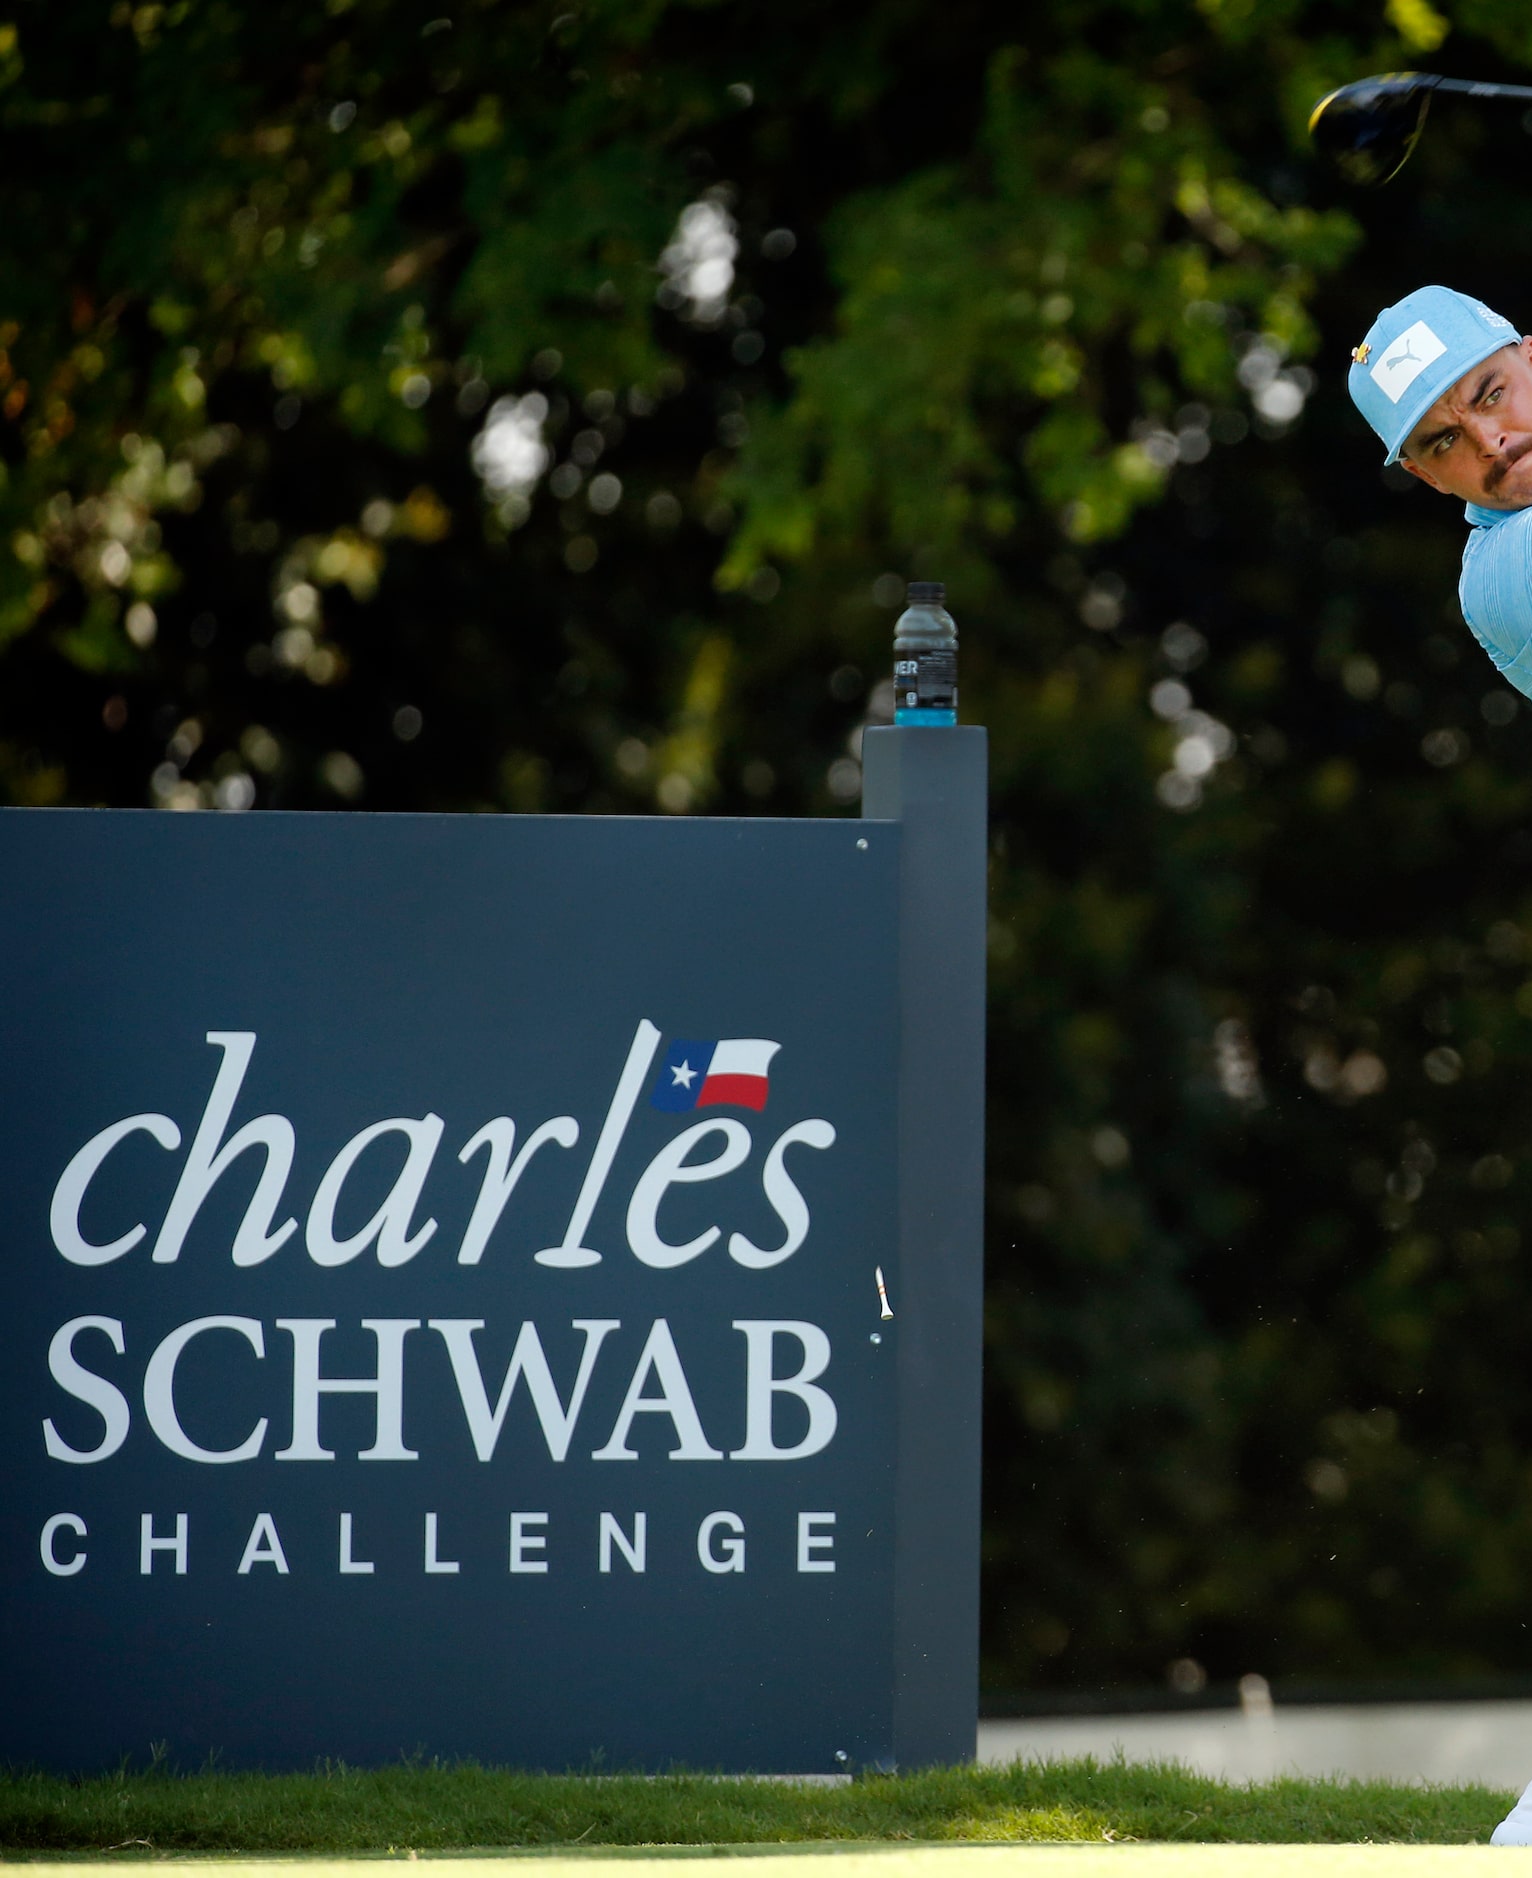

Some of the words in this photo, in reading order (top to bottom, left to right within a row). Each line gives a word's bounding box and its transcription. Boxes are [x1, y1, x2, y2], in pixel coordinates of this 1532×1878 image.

[50, 1018, 836, 1270] charles
[43, 1315, 838, 1464] SCHWAB
[40, 1510, 836, 1577] CHALLENGE
